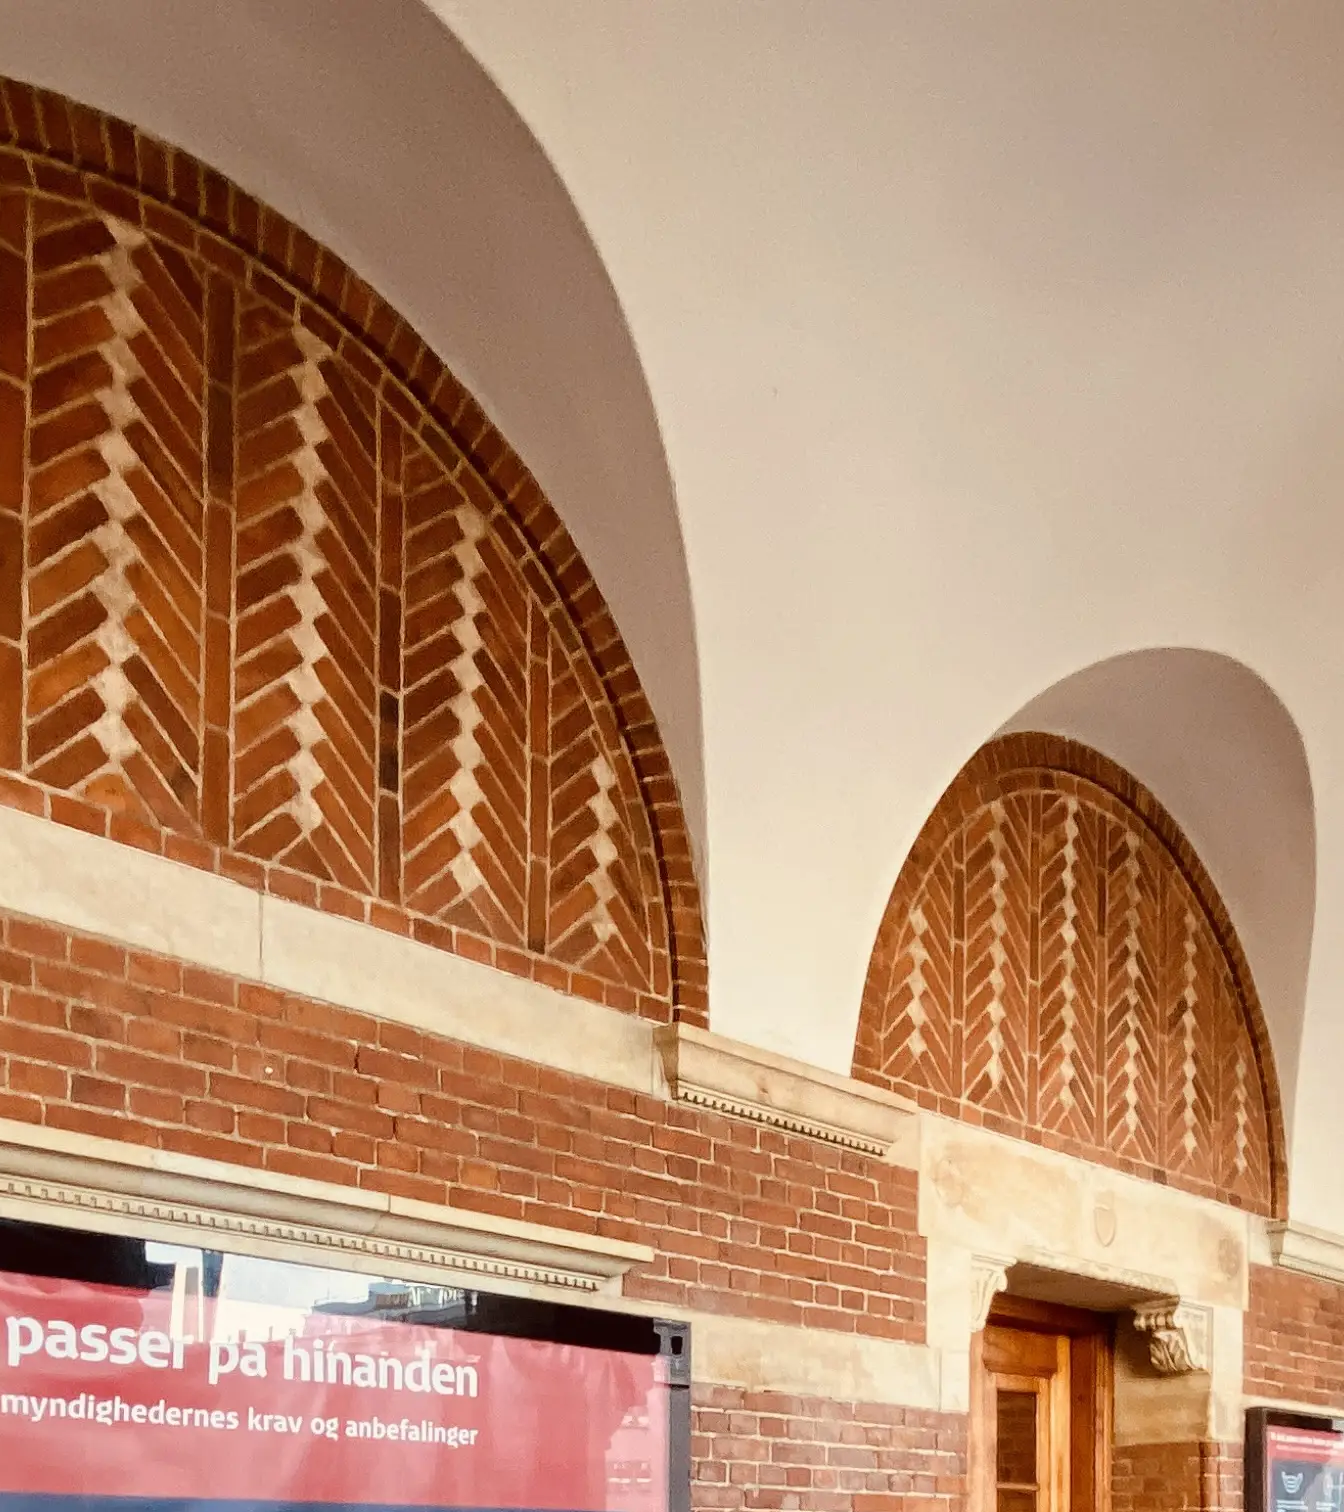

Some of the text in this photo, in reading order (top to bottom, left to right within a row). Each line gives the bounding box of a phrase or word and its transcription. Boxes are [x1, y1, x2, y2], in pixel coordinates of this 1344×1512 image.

[6, 1315, 191, 1370] passer
[284, 1332, 479, 1399] hinanden
[0, 1390, 239, 1431] myndighedernes
[247, 1407, 303, 1436] krav
[311, 1414, 338, 1440] og
[345, 1415, 479, 1448] anbefalinger
